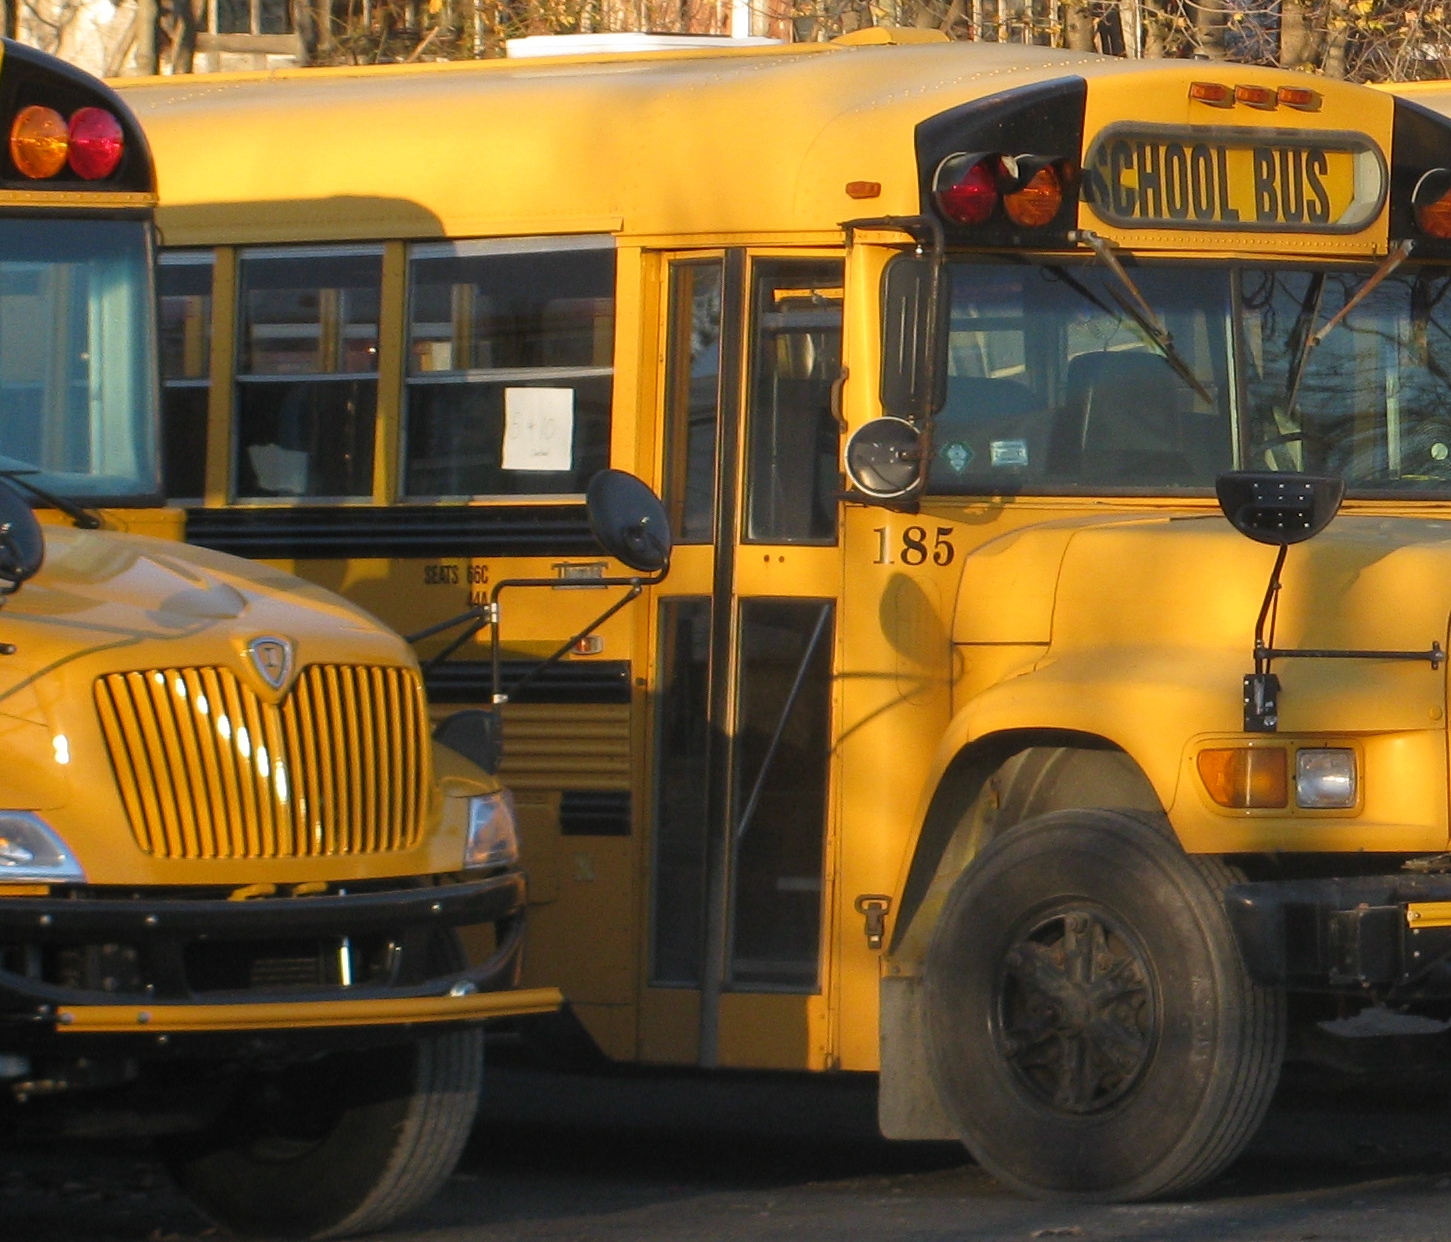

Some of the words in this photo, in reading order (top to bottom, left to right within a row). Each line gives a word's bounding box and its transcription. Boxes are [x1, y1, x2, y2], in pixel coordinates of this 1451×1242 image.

[1254, 147, 1330, 224] BUS
[872, 525, 955, 567] 185
[424, 565, 459, 585] SEATS
[467, 565, 489, 585] 66C
